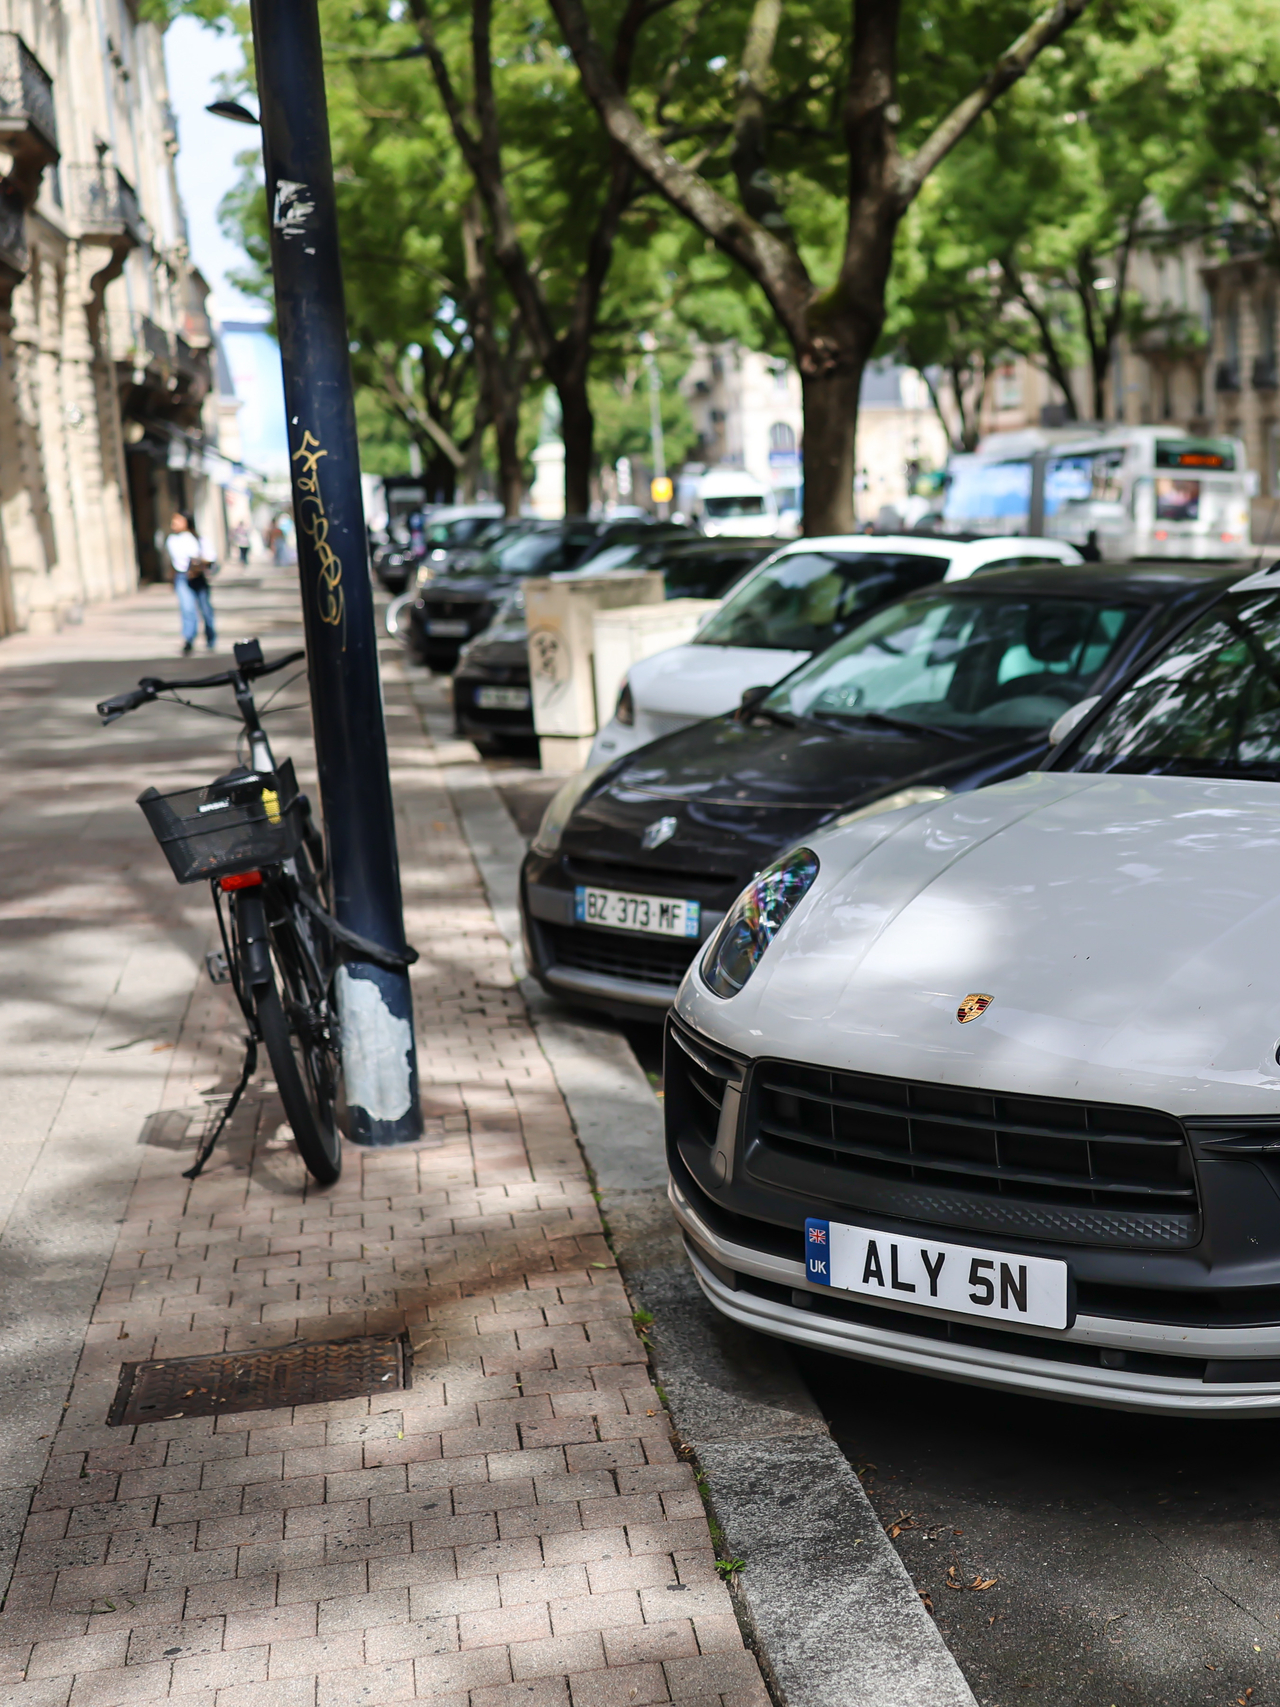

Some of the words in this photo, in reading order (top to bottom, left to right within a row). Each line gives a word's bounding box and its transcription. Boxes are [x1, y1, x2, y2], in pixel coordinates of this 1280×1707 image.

[809, 1258, 827, 1275] UK
[862, 1239, 946, 1298] ALY
[968, 1257, 1028, 1313] 5N
